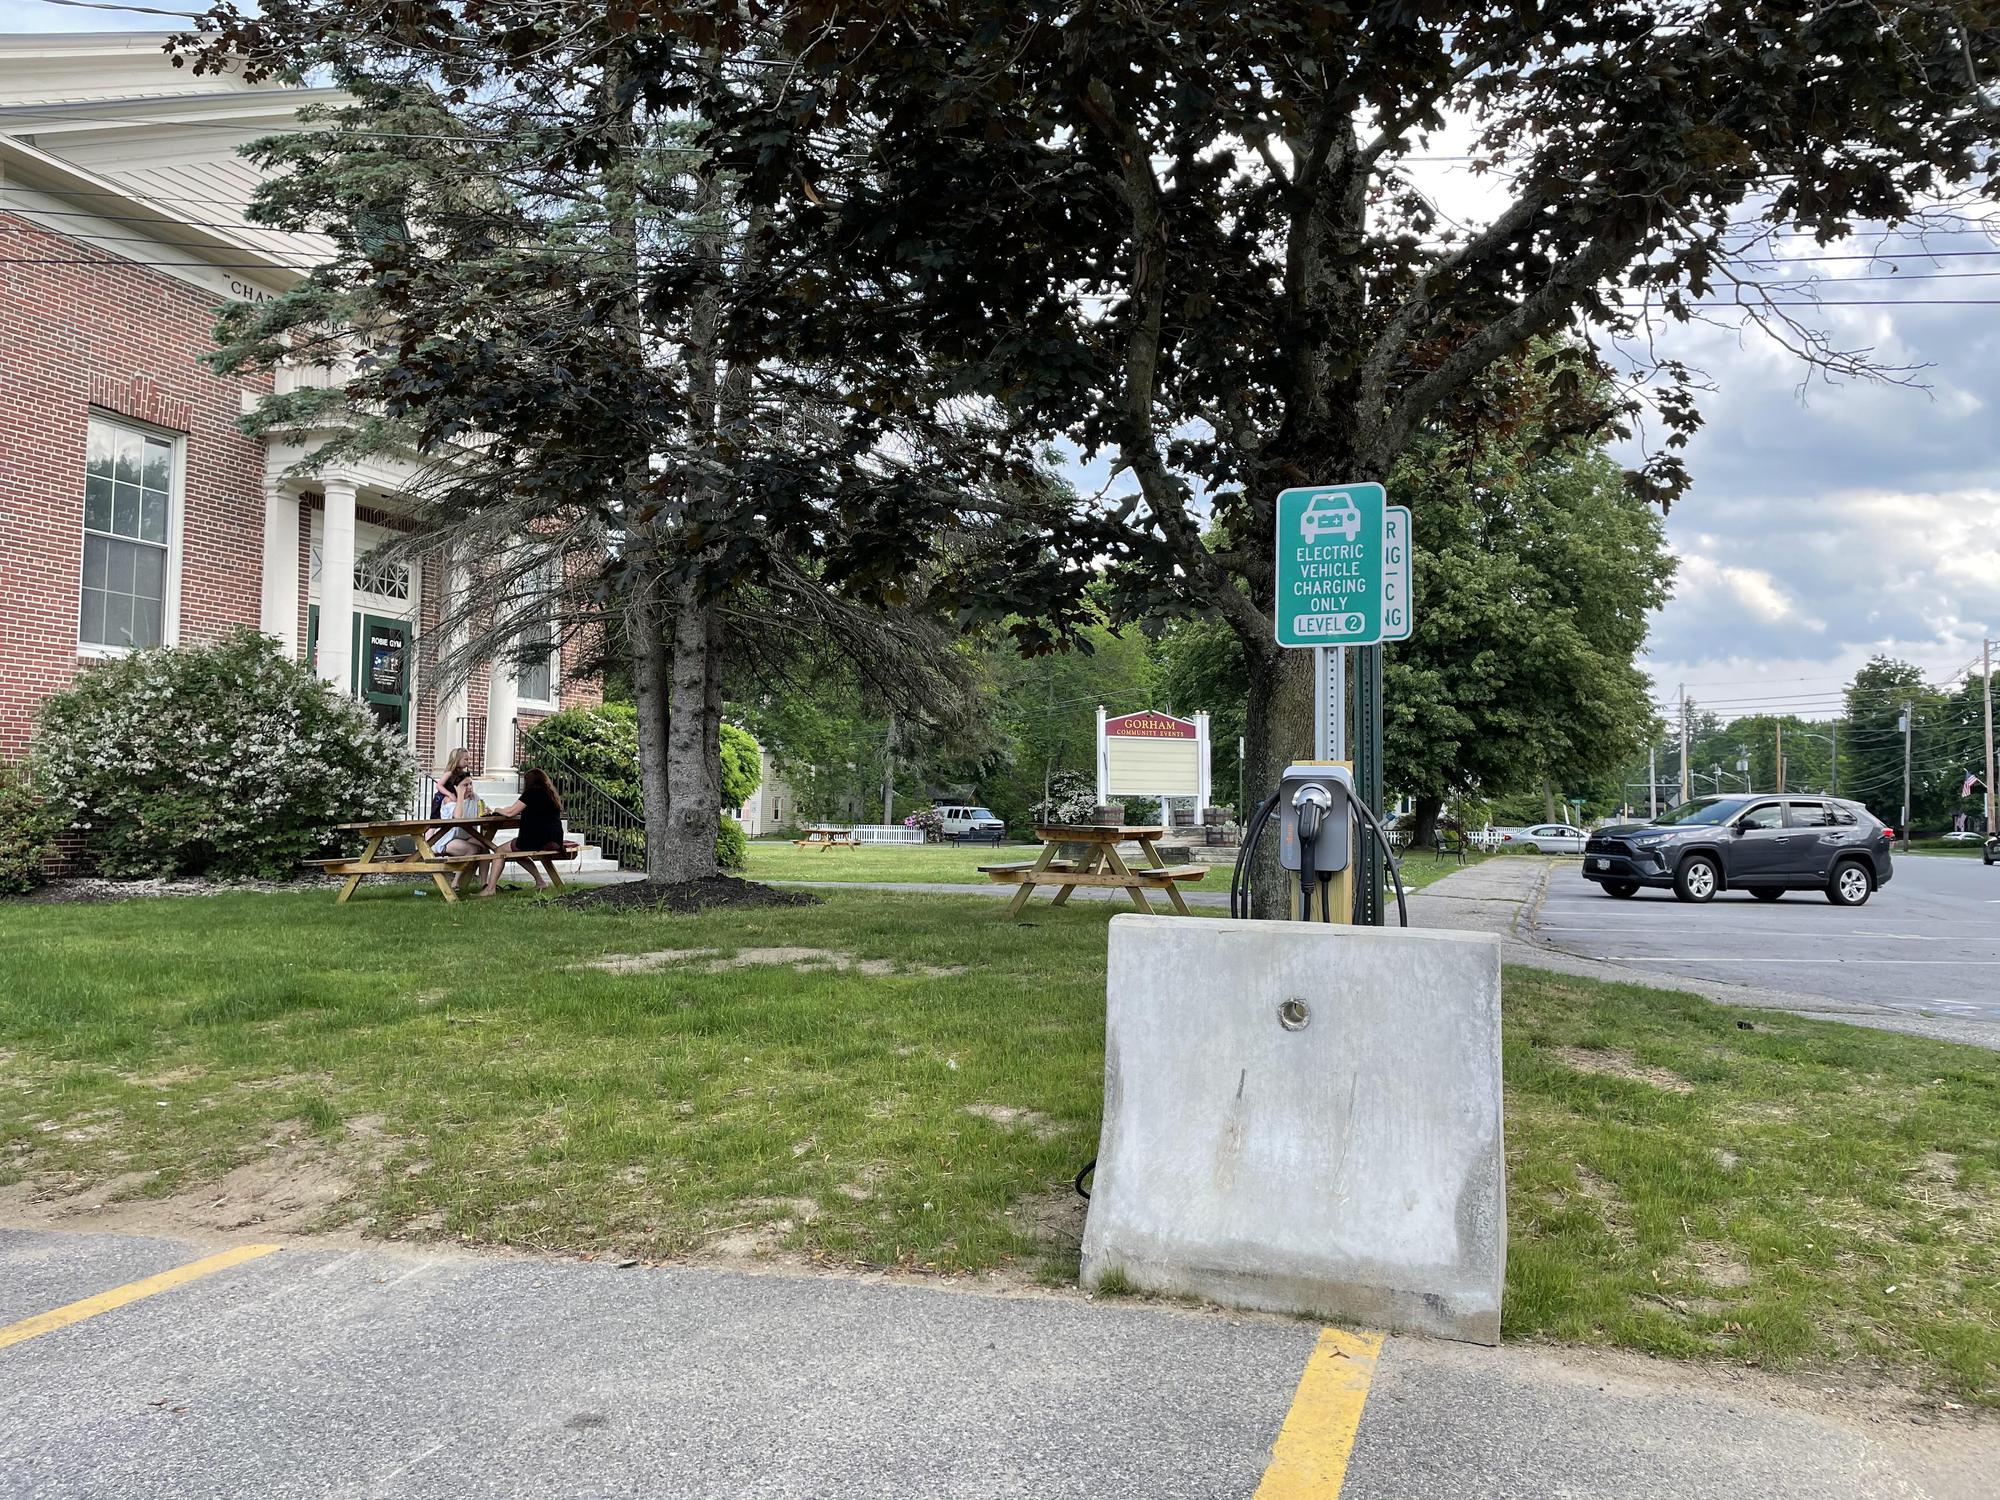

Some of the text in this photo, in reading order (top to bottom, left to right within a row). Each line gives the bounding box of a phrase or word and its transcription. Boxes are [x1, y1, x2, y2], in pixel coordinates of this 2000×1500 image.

[1296, 544, 1364, 562] ELECTRIC
[1300, 561, 1360, 578] VEHICLE
[1293, 578, 1366, 596] CHARGING
[1311, 596, 1348, 612] ONLY
[1298, 616, 1358, 633] LEVEL 2
[389, 639, 402, 648] GYM
[1124, 719, 1176, 730] GORHAM
[1116, 729, 1184, 738] COMMUNITY EVENTS
